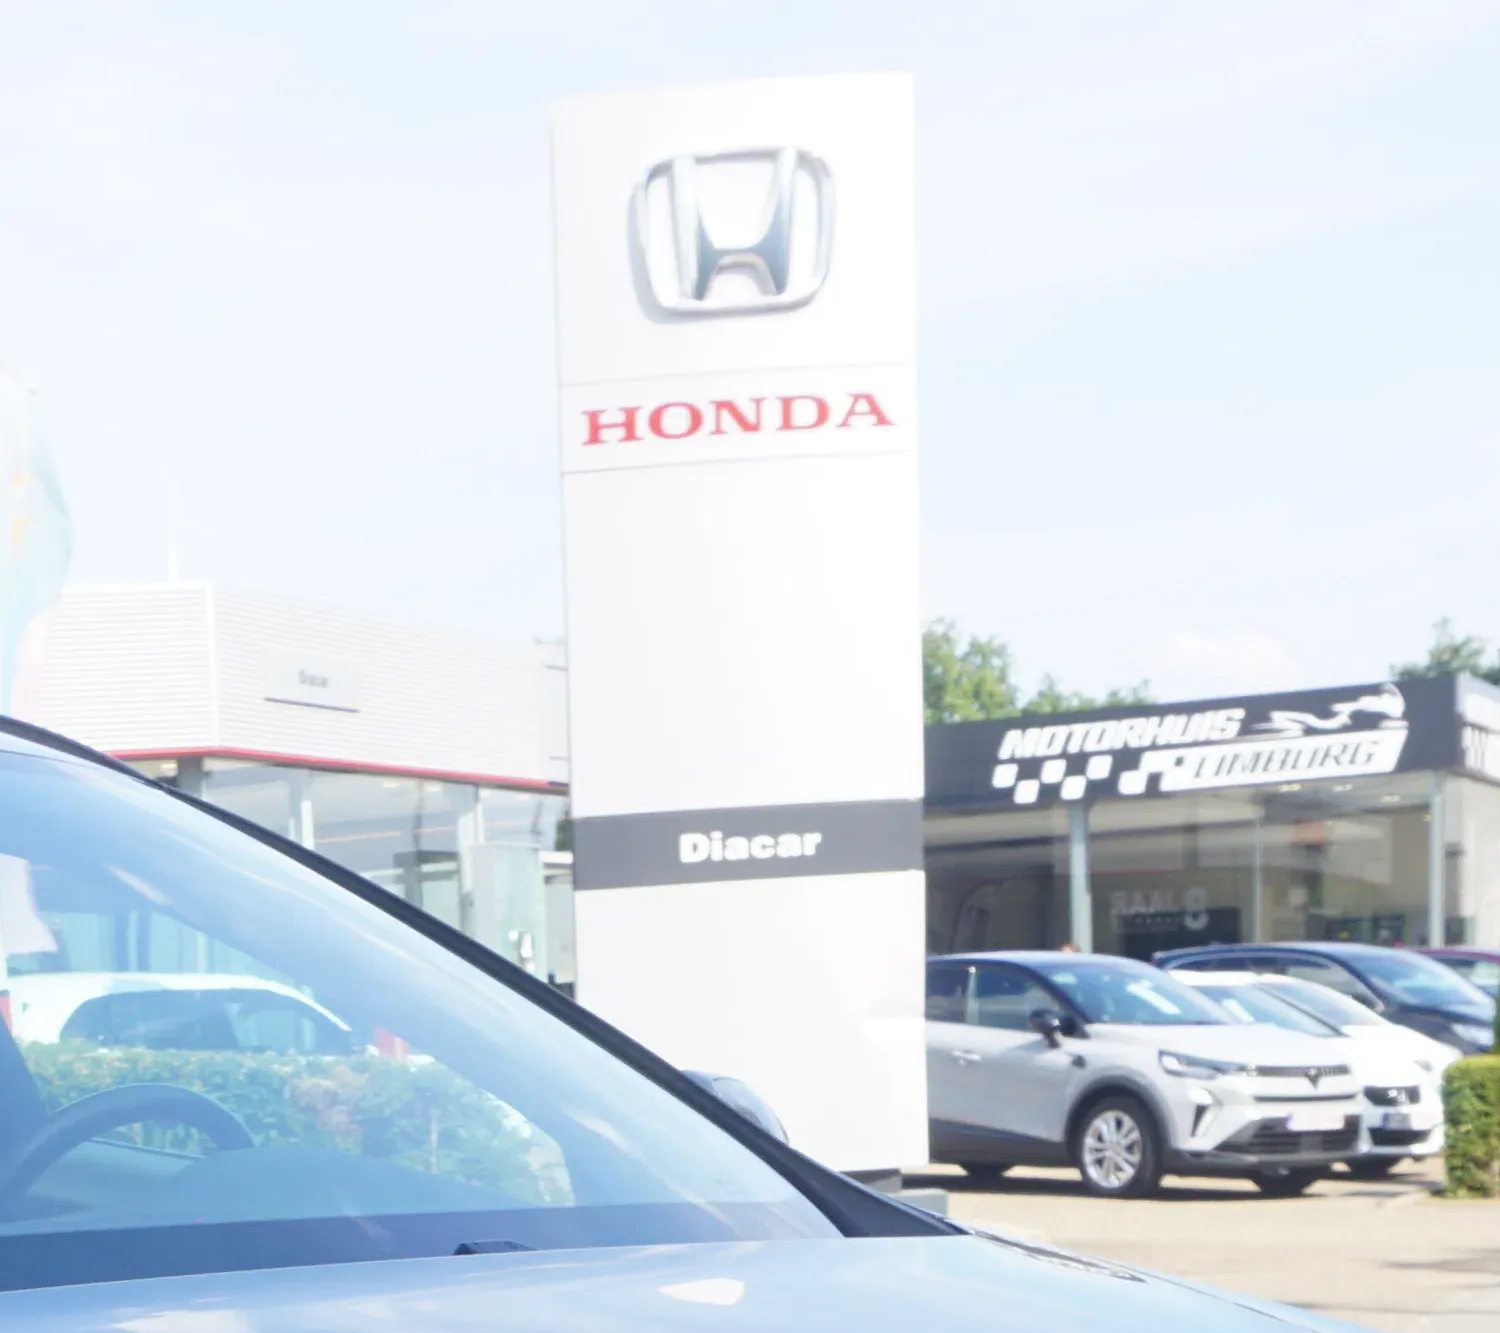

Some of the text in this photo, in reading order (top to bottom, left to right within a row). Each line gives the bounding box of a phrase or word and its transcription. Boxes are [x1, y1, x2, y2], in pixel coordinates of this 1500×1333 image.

[582, 392, 894, 446] HONDA
[999, 708, 1245, 760] MOTORHUIS
[1194, 741, 1380, 779] LIMBURG
[679, 827, 822, 864] Diacar
